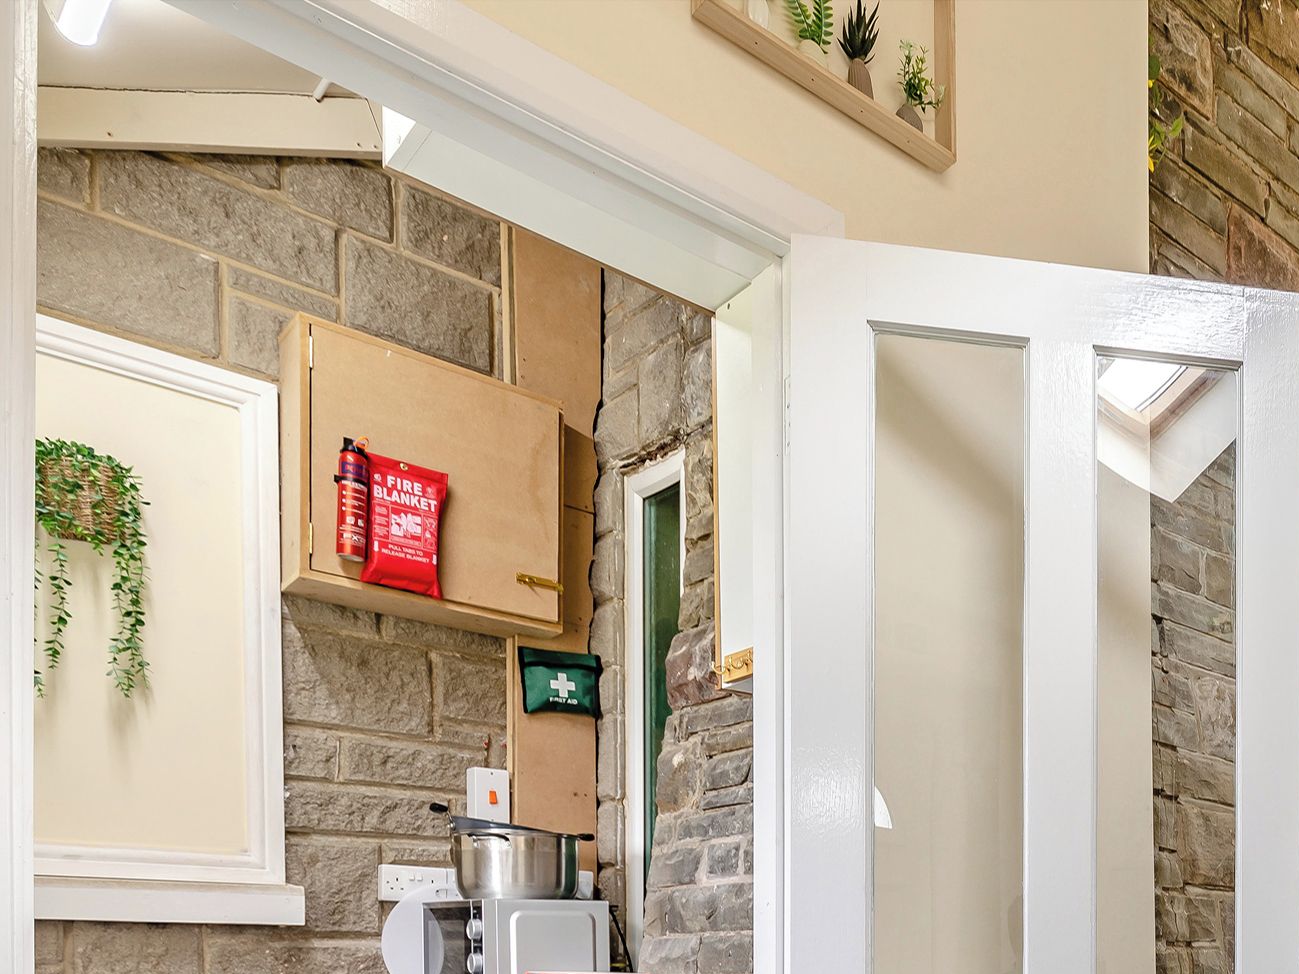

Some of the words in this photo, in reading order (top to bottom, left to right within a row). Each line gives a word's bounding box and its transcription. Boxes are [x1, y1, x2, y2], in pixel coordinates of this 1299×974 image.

[387, 475, 423, 496] FIRE
[373, 484, 437, 513] BLANKET
[381, 548, 406, 559] RELEASE
[406, 554, 430, 564] BLANKET
[388, 544, 402, 552] PULL
[549, 696, 566, 704] FIRST
[567, 697, 578, 706] AID
